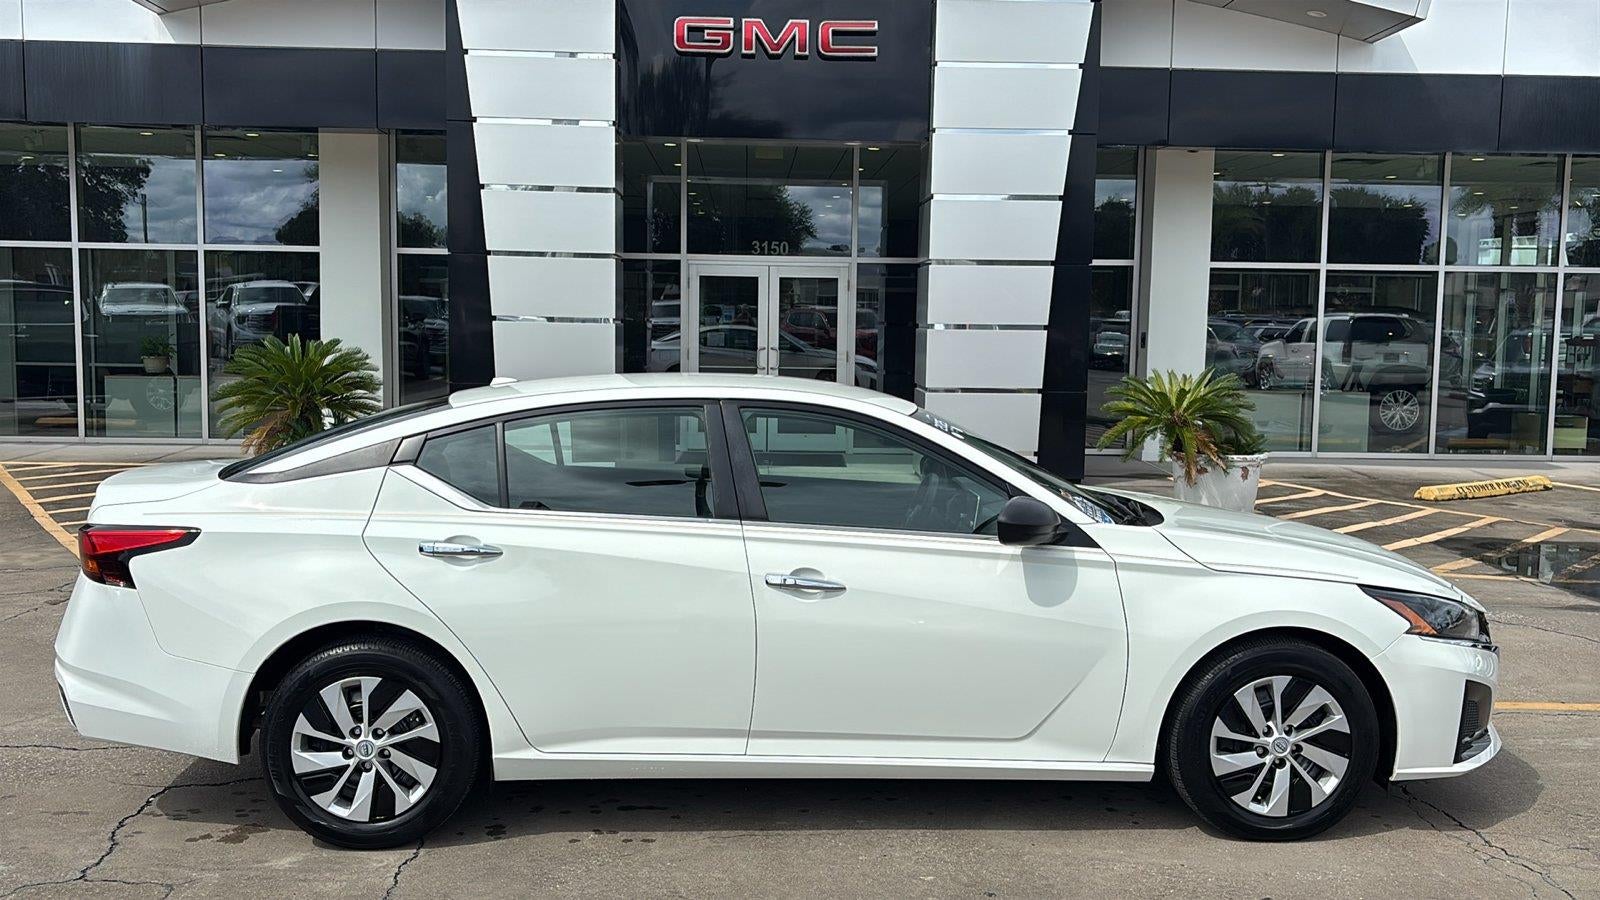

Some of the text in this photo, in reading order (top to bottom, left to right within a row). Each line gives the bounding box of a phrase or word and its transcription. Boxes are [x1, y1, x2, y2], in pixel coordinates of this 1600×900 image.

[674, 16, 878, 58] GMC
[752, 240, 789, 255] 3150
[1456, 483, 1496, 494] CUSTOMER
